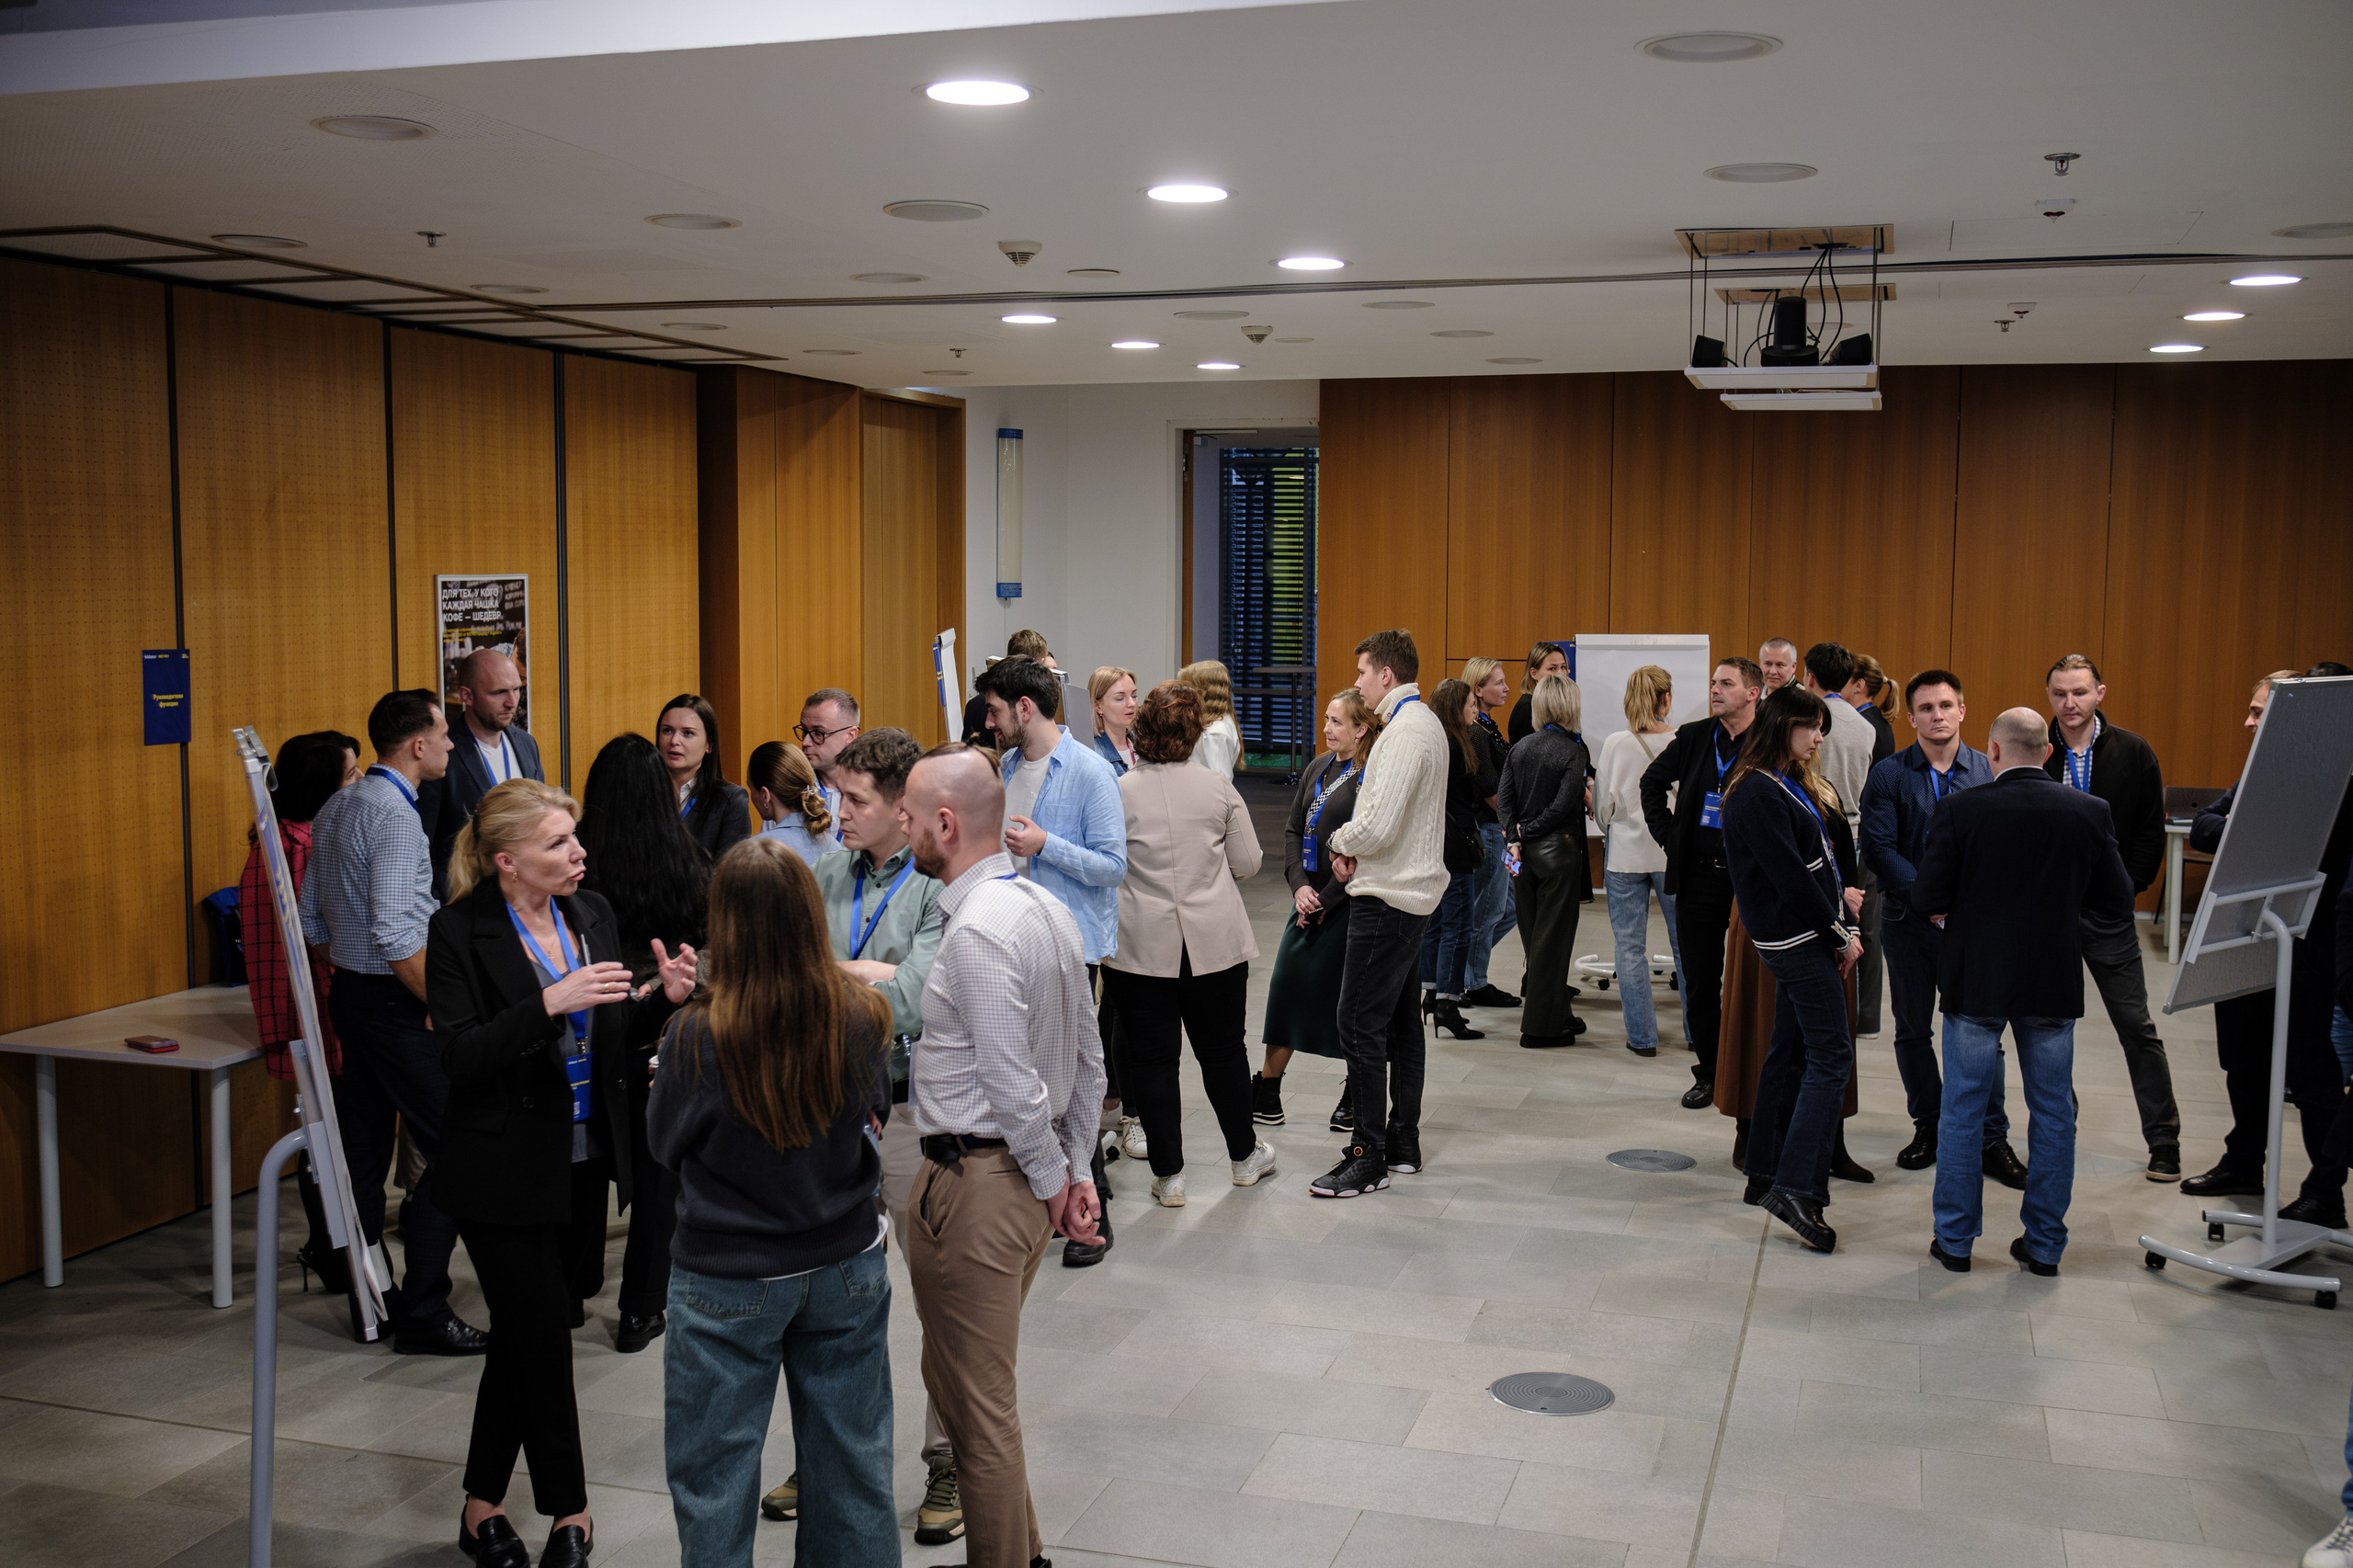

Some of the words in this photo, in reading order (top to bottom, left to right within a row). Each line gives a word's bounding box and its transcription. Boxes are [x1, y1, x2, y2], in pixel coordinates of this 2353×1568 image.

[442, 588, 459, 600] ДЛЯ
[474, 587, 480, 597] У
[480, 587, 499, 597] КОГО
[442, 600, 473, 611] КАЖДАЯ
[474, 598, 499, 608] ЧАШКА
[442, 612, 463, 622] КОФЕ
